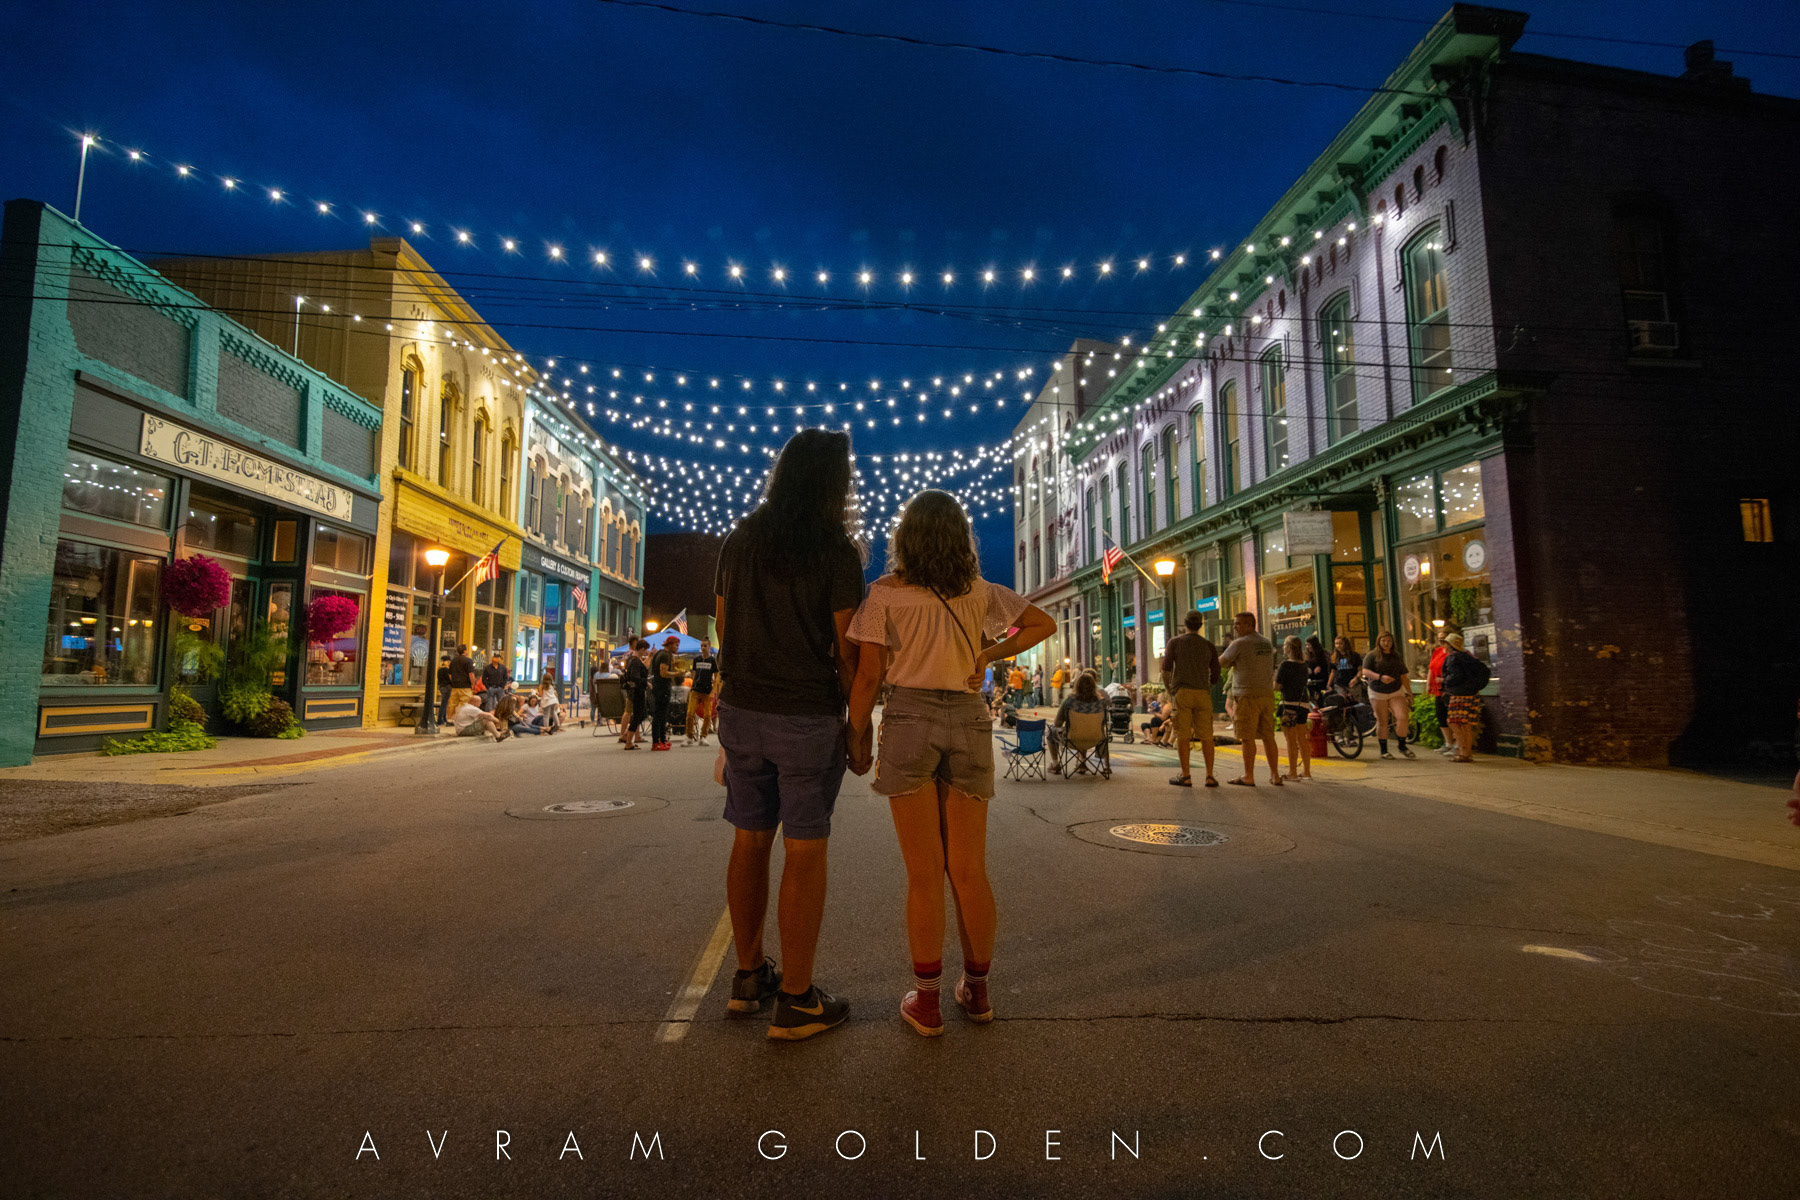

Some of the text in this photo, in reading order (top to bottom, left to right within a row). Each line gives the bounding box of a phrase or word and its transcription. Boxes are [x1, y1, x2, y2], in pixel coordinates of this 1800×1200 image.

[221, 447, 337, 513] HOMESTEAD
[541, 556, 557, 571] GALLERY
[561, 564, 575, 579] CUSTOM
[1273, 621, 1307, 632] CREATIONS
